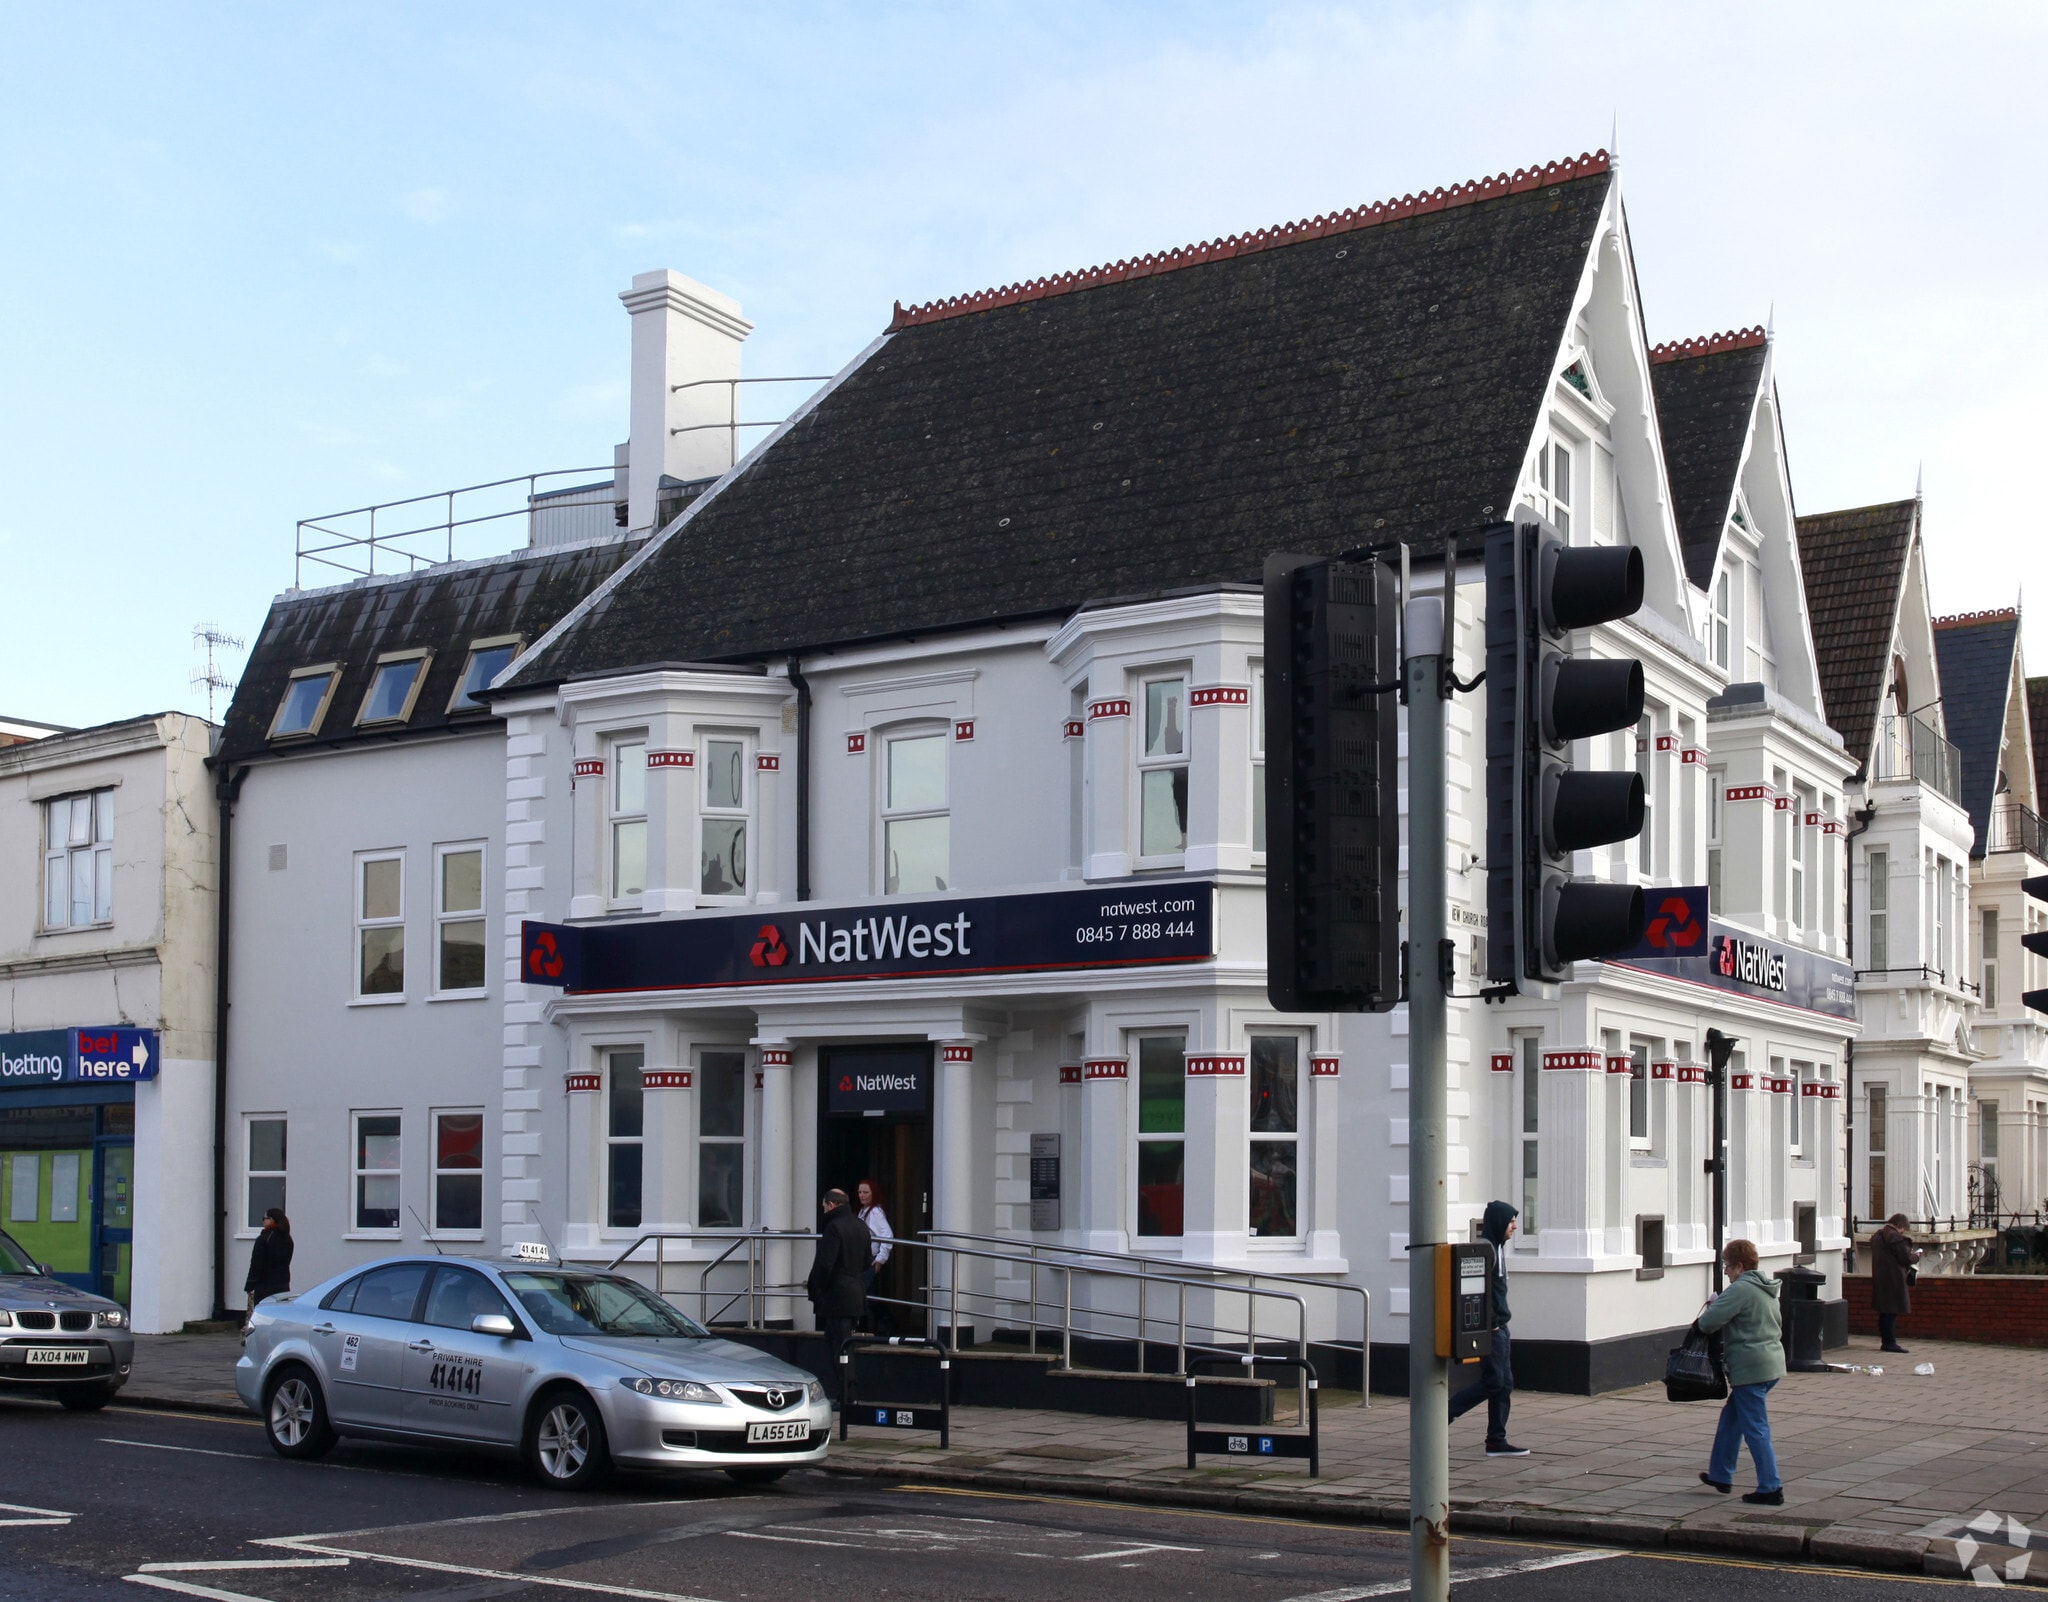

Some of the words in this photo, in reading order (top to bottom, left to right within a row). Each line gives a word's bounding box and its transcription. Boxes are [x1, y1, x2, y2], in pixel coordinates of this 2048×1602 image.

[1101, 899, 1195, 917] natwest.com
[800, 911, 971, 965] NatWest
[1076, 926, 1113, 943] 0845
[1119, 925, 1127, 940] 7
[1132, 923, 1160, 940] 888
[1165, 921, 1194, 937] 444
[1736, 939, 1787, 992] NatWest
[79, 1031, 118, 1053] bet
[2, 1052, 62, 1081] betting
[79, 1056, 131, 1077] here
[856, 1074, 917, 1091] NatWest
[521, 1245, 529, 1253] 41
[531, 1246, 538, 1254] 41
[346, 1336, 359, 1347] 462
[32, 1351, 62, 1362] AX04
[64, 1351, 86, 1362] MWN
[432, 1352, 463, 1364] PRIVATE
[464, 1357, 484, 1367] HIRE
[878, 1411, 886, 1422] P
[753, 1425, 784, 1440] LA55
[787, 1423, 806, 1439] EAX
[1262, 1439, 1270, 1451] P
